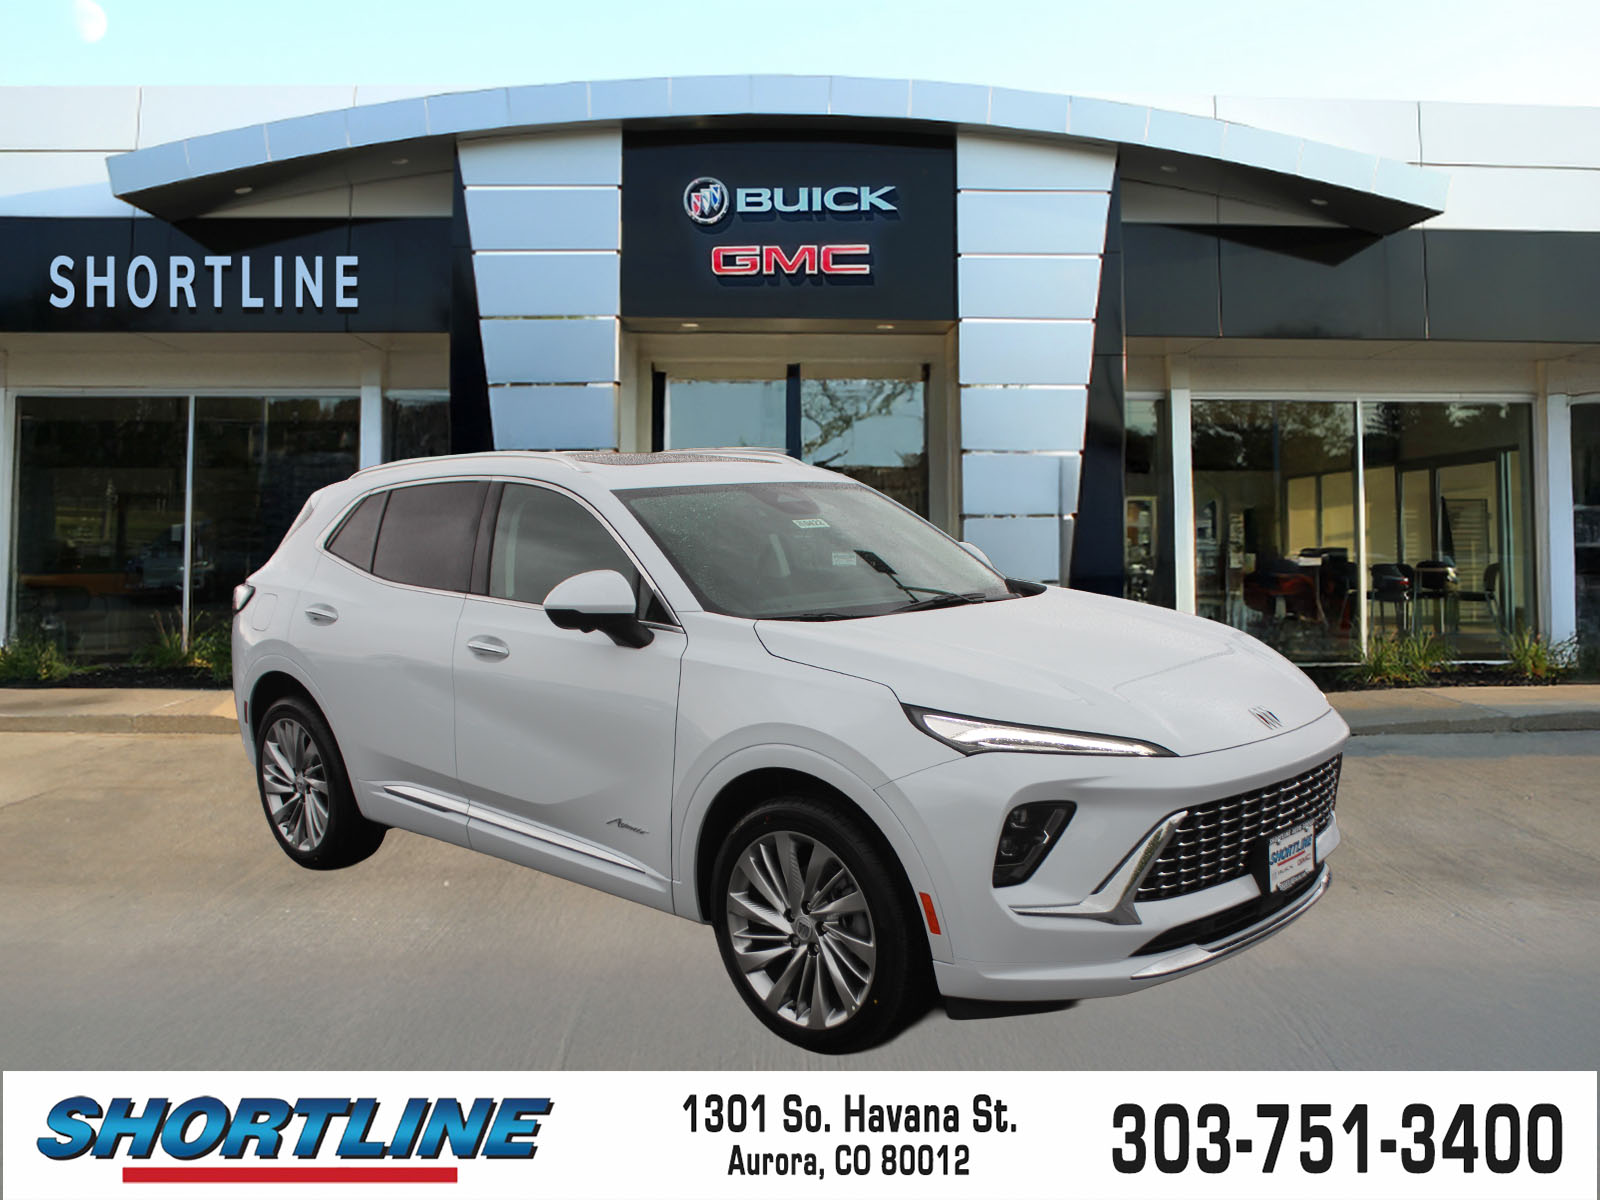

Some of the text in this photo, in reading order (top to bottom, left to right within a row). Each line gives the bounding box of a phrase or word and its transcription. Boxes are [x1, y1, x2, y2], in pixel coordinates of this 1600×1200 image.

[736, 185, 898, 213] BUICK
[711, 244, 871, 276] GMC
[49, 255, 359, 308] SHORTLINE
